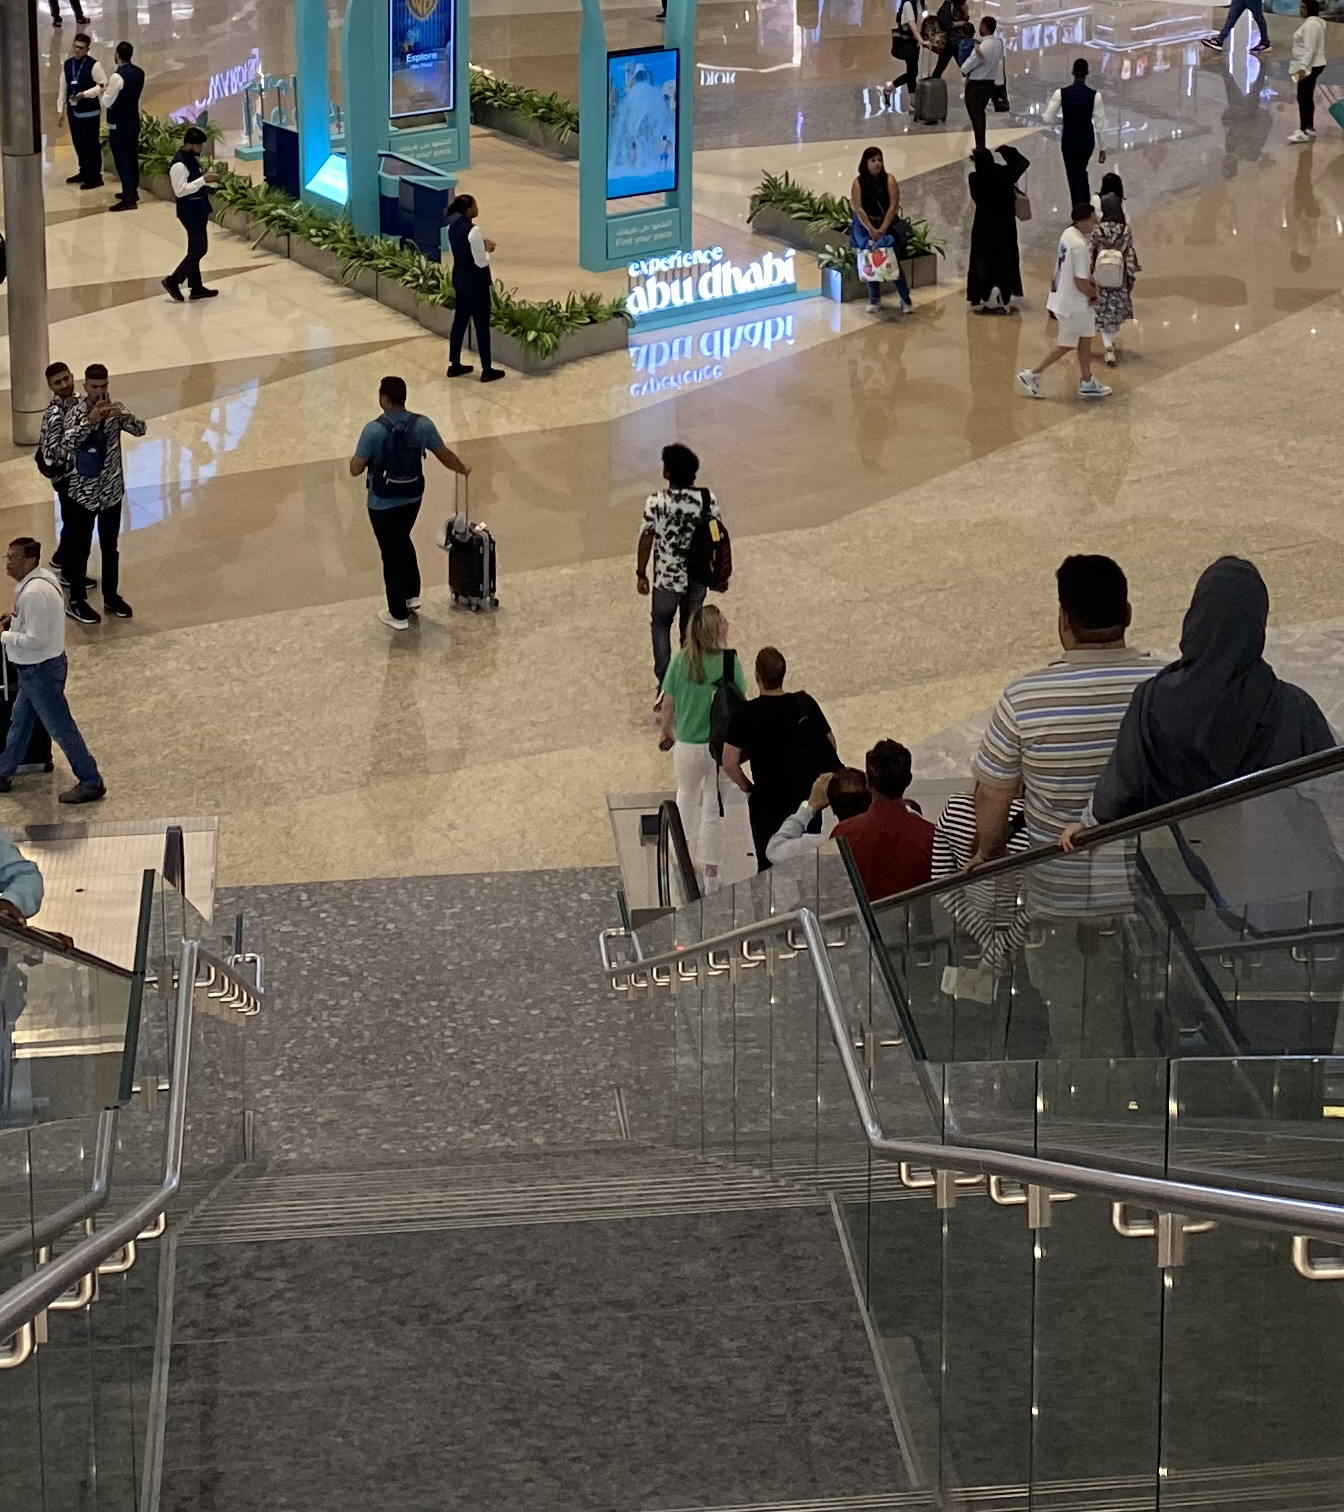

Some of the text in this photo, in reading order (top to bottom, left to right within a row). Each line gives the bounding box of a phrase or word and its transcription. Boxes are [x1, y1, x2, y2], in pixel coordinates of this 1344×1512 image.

[406, 51, 437, 64] Explore
[616, 231, 673, 247] Find your pace
[628, 246, 724, 277] experience
[626, 276, 694, 316] abu
